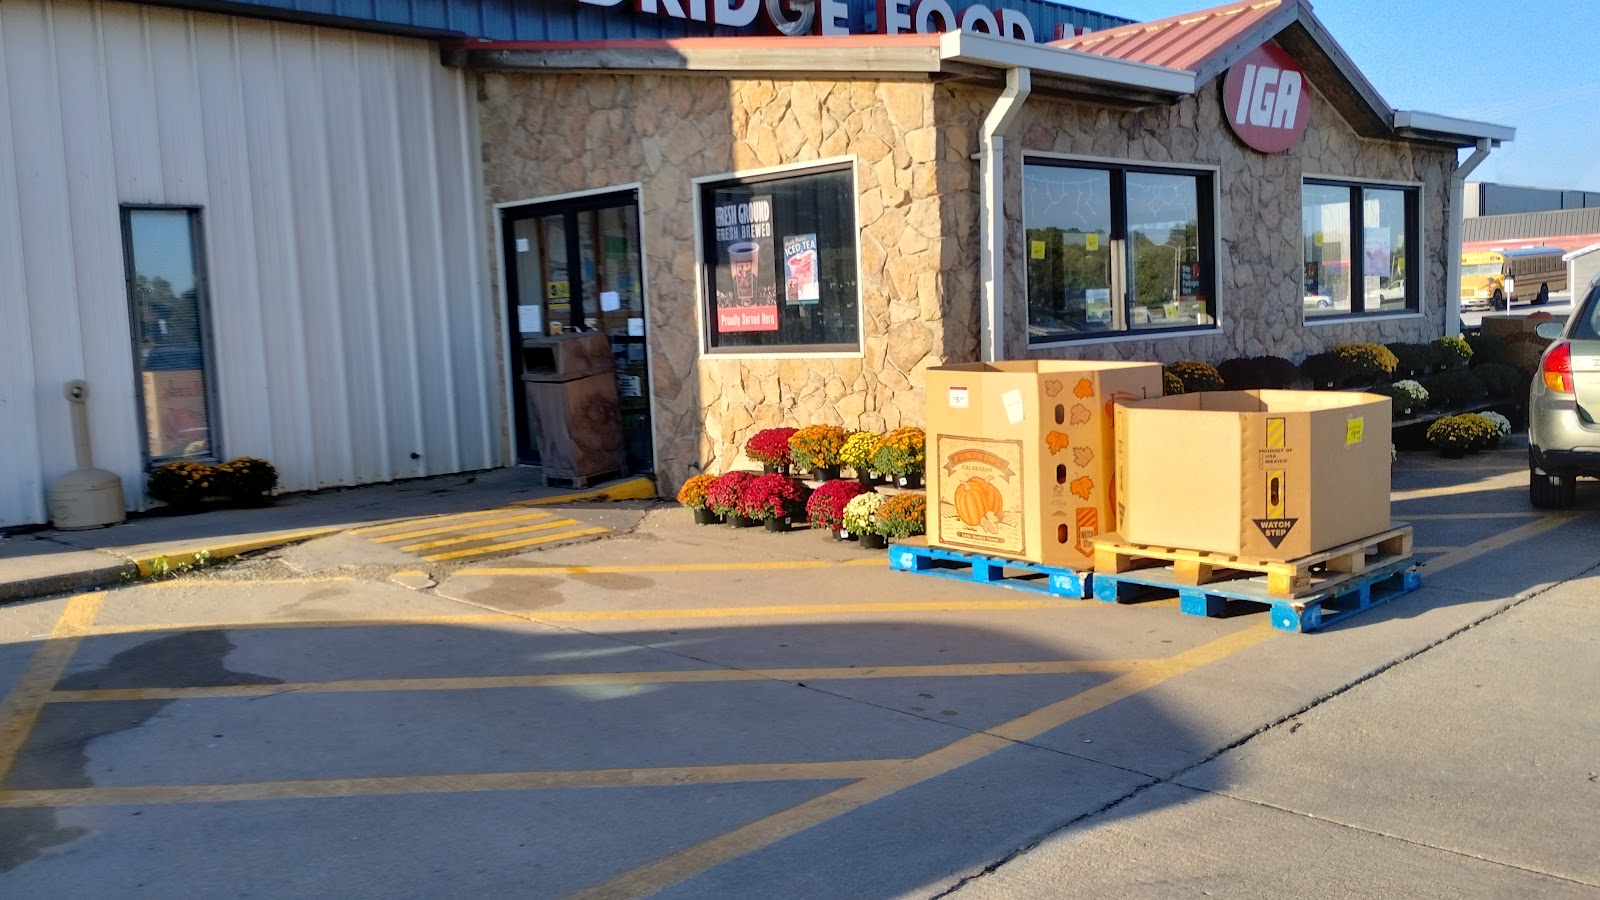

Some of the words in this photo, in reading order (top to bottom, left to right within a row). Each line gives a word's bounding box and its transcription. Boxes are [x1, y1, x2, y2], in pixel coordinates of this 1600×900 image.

[886, 0, 1035, 43] FOOD
[1235, 64, 1302, 129] IGA
[715, 205, 737, 227] FRESH
[738, 201, 770, 224] GROUND
[716, 227, 739, 241] FRESH
[741, 222, 771, 239] BREWED
[785, 243, 801, 257] ICED
[802, 240, 816, 251] TEA
[721, 314, 740, 328] Proudly
[742, 313, 760, 325] Served
[761, 312, 775, 325] Here
[953, 451, 1002, 466] PUMPKINS
[1260, 520, 1291, 529] WATCH
[1265, 528, 1287, 537] STEP
